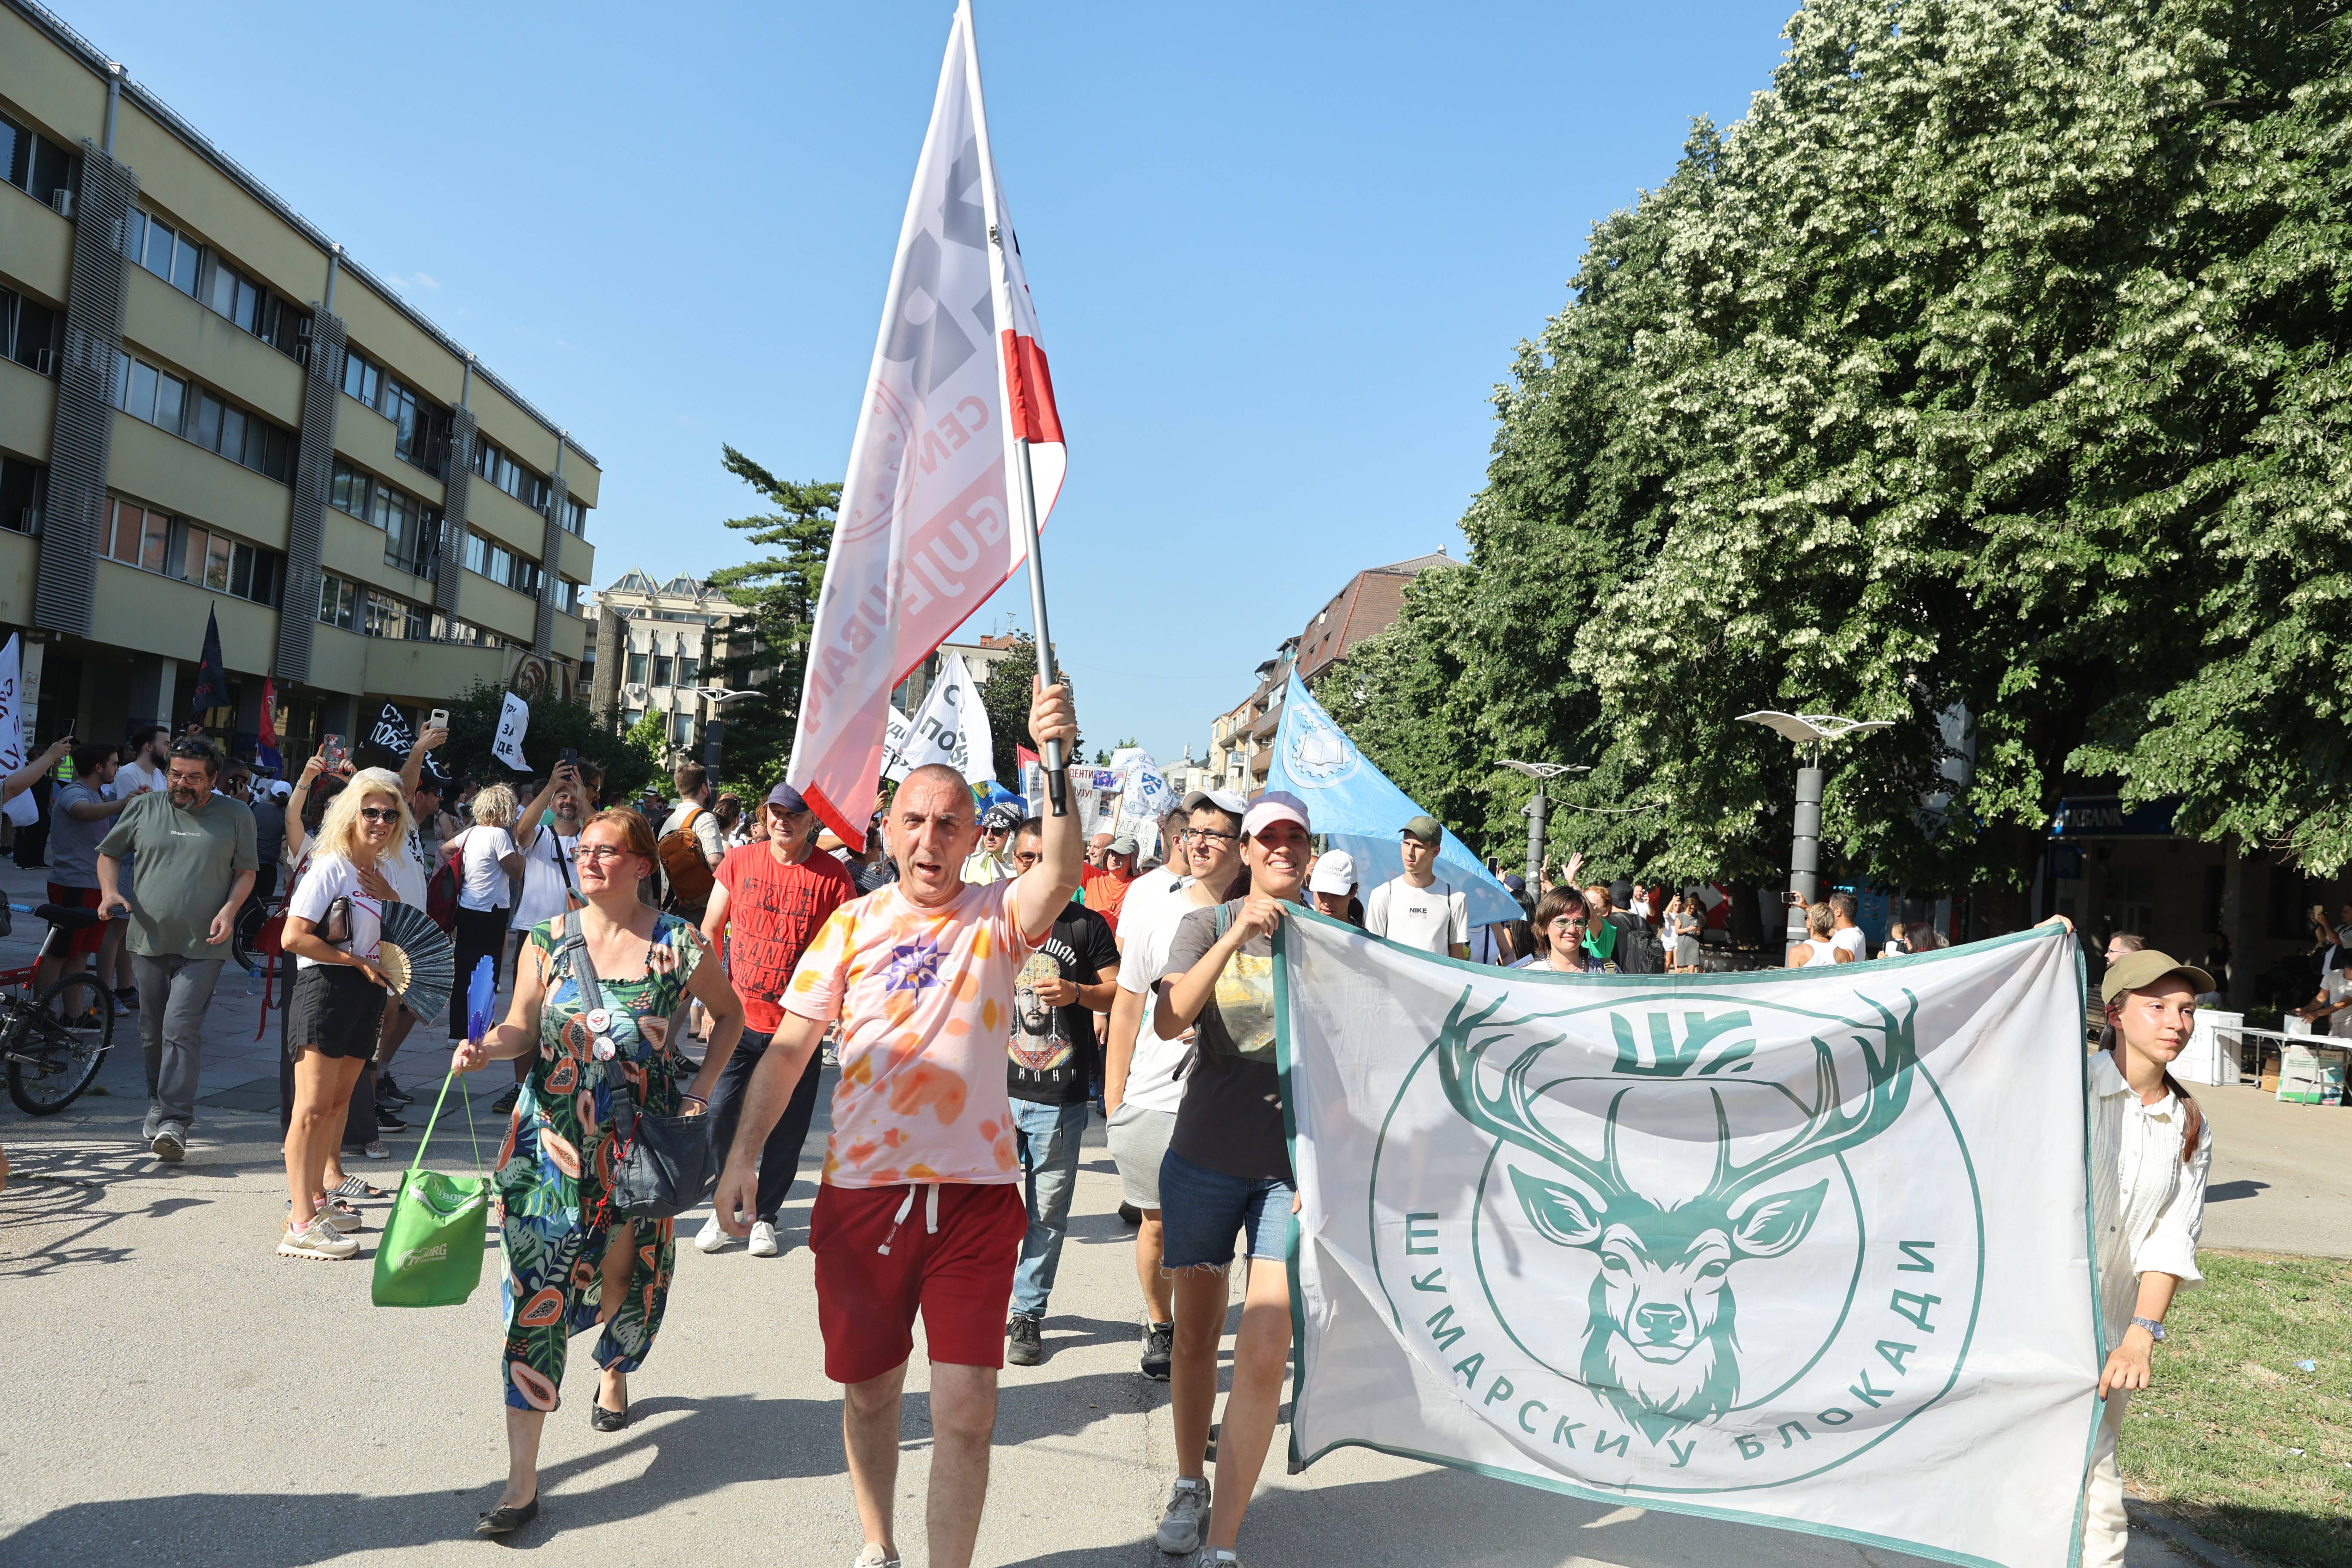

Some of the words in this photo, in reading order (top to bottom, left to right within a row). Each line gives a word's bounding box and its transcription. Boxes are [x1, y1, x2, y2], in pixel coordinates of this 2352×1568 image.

[1406, 1212, 1630, 1458] ШУМАРСКИ
[1666, 1440, 1697, 1467] У
[1734, 1241, 1942, 1461] БЛОКАДИ
